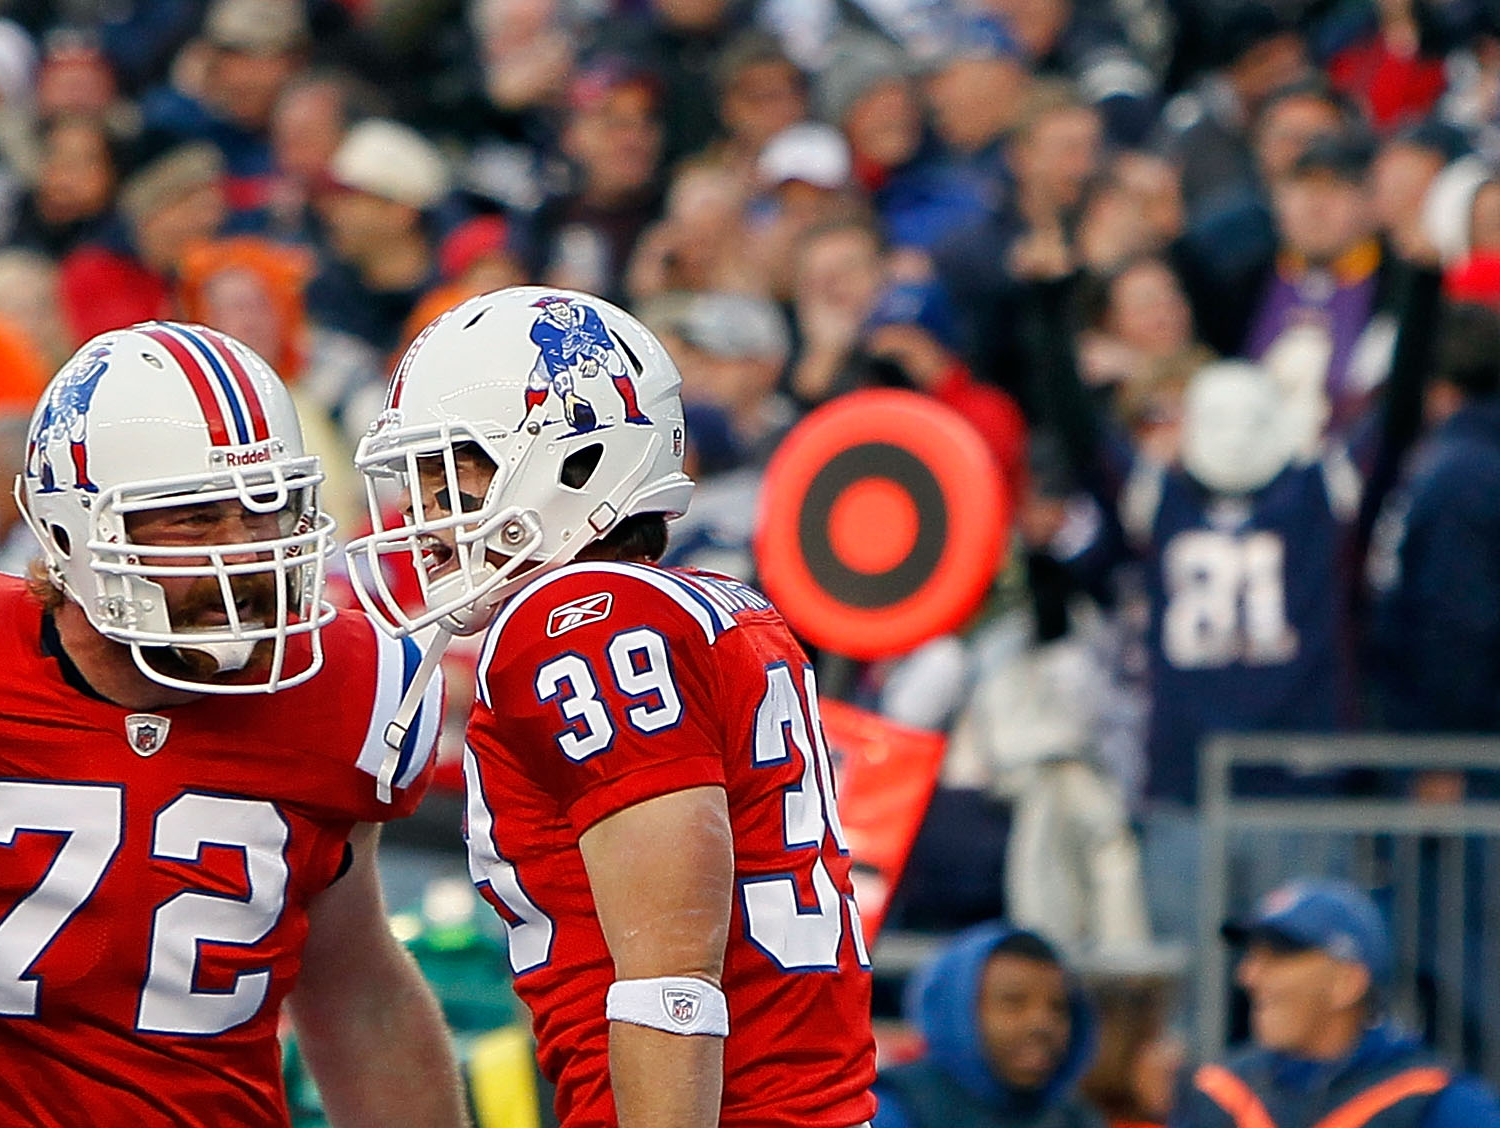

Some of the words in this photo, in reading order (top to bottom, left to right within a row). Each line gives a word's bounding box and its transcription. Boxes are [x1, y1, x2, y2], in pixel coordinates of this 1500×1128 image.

[226, 444, 272, 467] Riddell
[1162, 532, 1298, 669] 81
[536, 626, 684, 762] 39
[738, 660, 872, 973] 3
